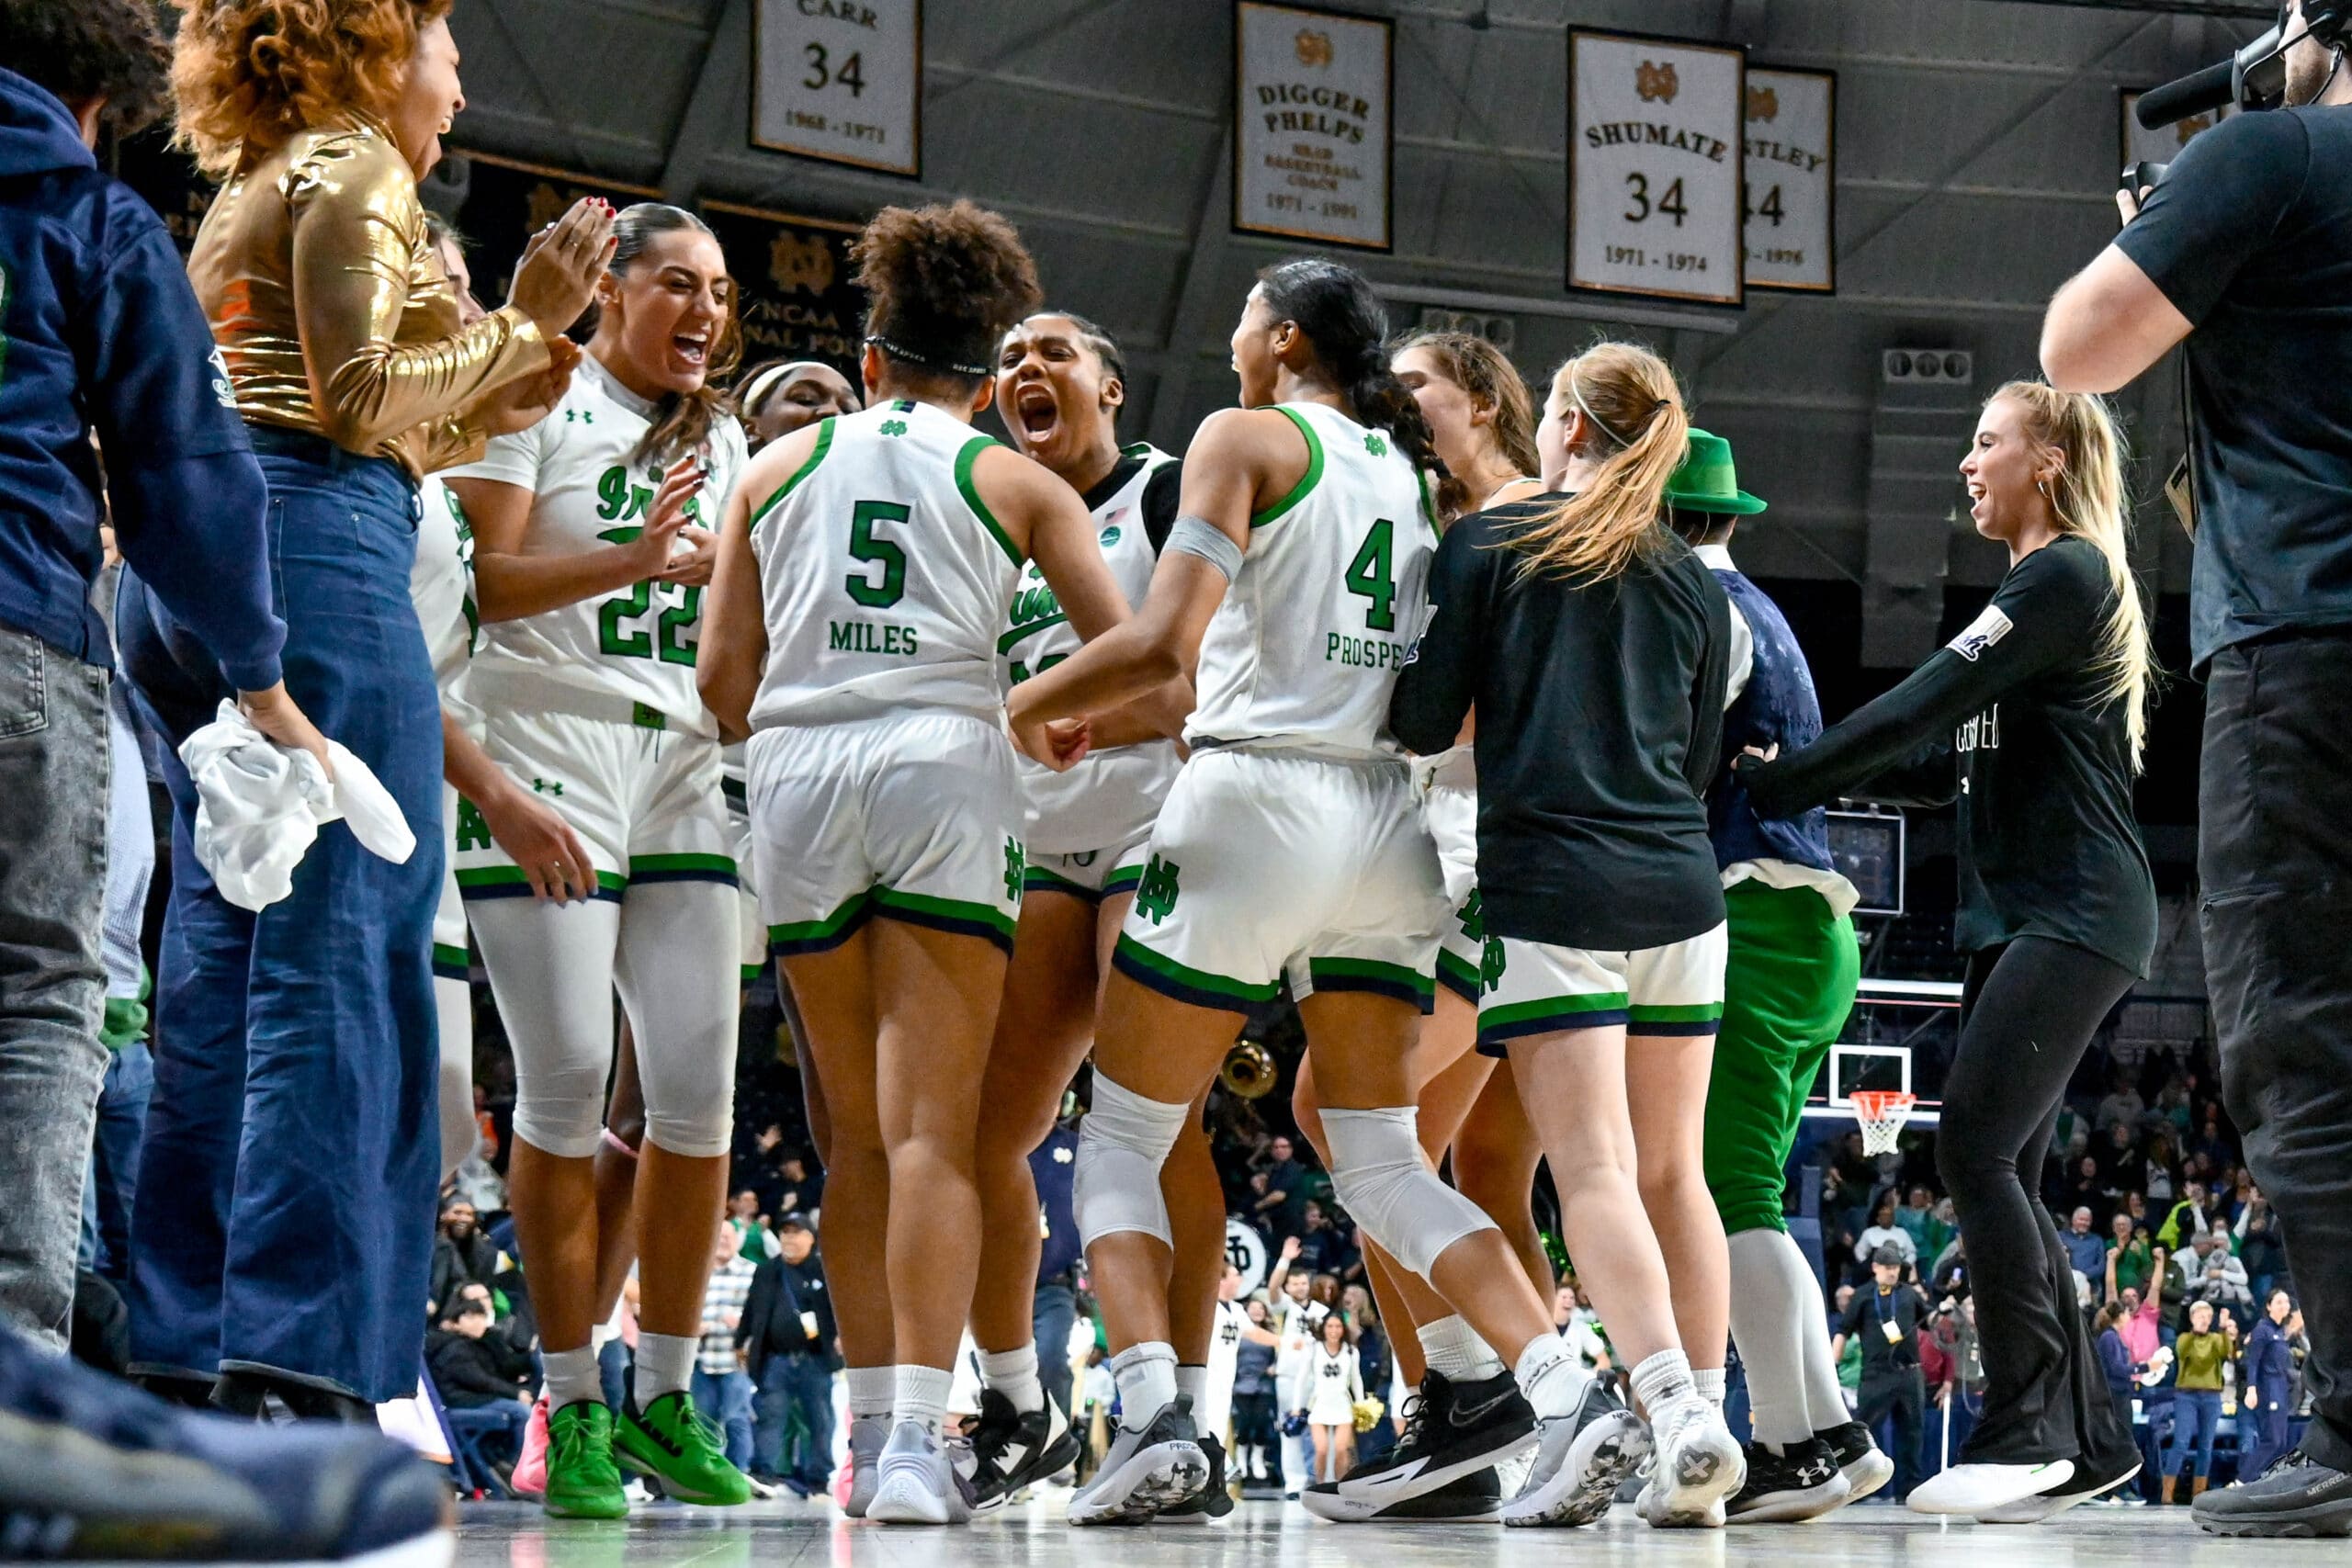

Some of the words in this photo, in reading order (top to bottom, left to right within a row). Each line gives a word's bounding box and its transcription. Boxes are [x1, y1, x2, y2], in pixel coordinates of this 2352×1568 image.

[797, 0, 878, 29] CARR
[802, 41, 865, 97] 34
[1257, 84, 1370, 121] DIGGER
[1264, 111, 1365, 144] PHELPS
[1585, 121, 1728, 164] SHUMATE
[1624, 172, 1688, 228] 34
[1606, 245, 1645, 266] 1971
[1667, 254, 1706, 273] 1974
[763, 299, 840, 330] NCAA
[746, 324, 802, 351] NAL
[846, 501, 910, 609] 5
[1344, 518, 1396, 633] 4
[599, 578, 702, 668] 22
[830, 621, 918, 658] MILES
[1326, 632, 1403, 673] PROSPE
